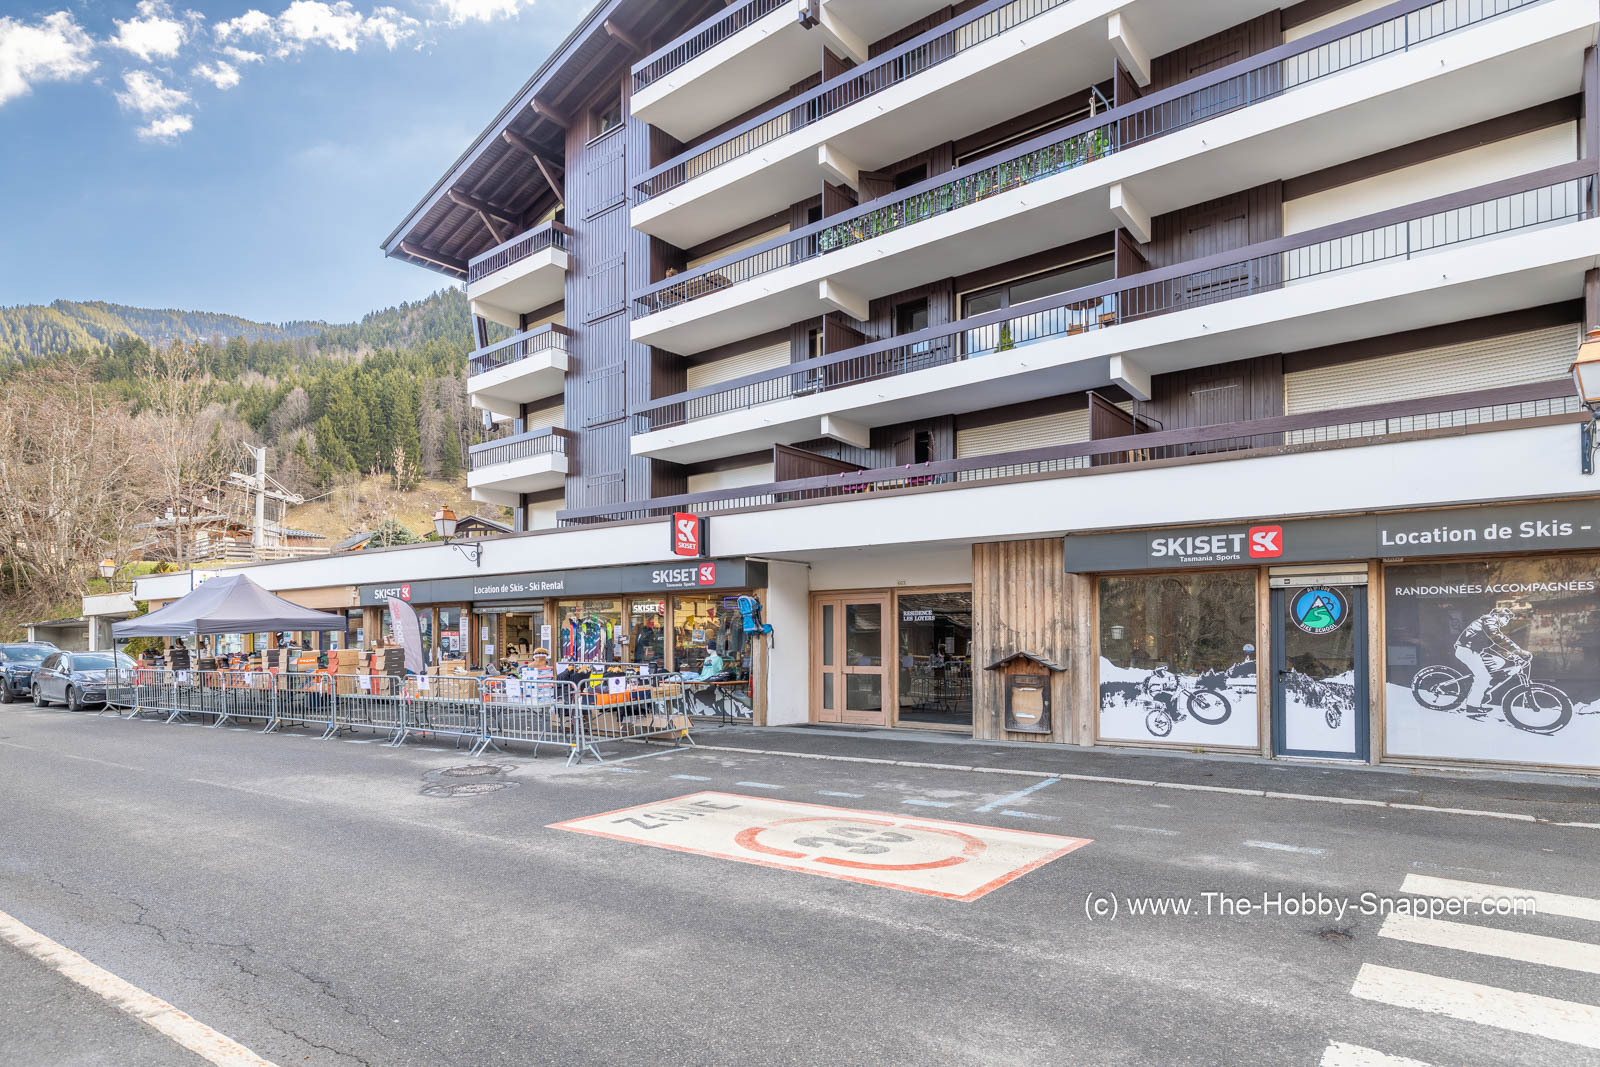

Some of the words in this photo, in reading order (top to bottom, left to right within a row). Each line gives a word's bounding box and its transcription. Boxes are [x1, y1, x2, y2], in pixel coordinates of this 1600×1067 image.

[1382, 526, 1477, 546] Location
[1483, 523, 1513, 540] de
[1519, 519, 1573, 538] Skis
[1151, 533, 1245, 557] SKISET
[1179, 555, 1213, 563] Tasmania
[1215, 554, 1241, 562] Sports
[652, 567, 698, 584] SKISET
[374, 587, 401, 600] SKISET
[474, 584, 500, 594] Location
[500, 584, 509, 593] de
[509, 583, 524, 593] Skis
[529, 582, 541, 591] Ski
[541, 580, 564, 591] Rental
[1395, 583, 1482, 596] RANDONNÉES
[1484, 580, 1595, 594] ACCOMPAGNÉES
[633, 604, 659, 613] SKISET
[1300, 622, 1312, 632] BIKE
[1314, 623, 1338, 633] SCHOOL
[609, 799, 743, 831] ZONE
